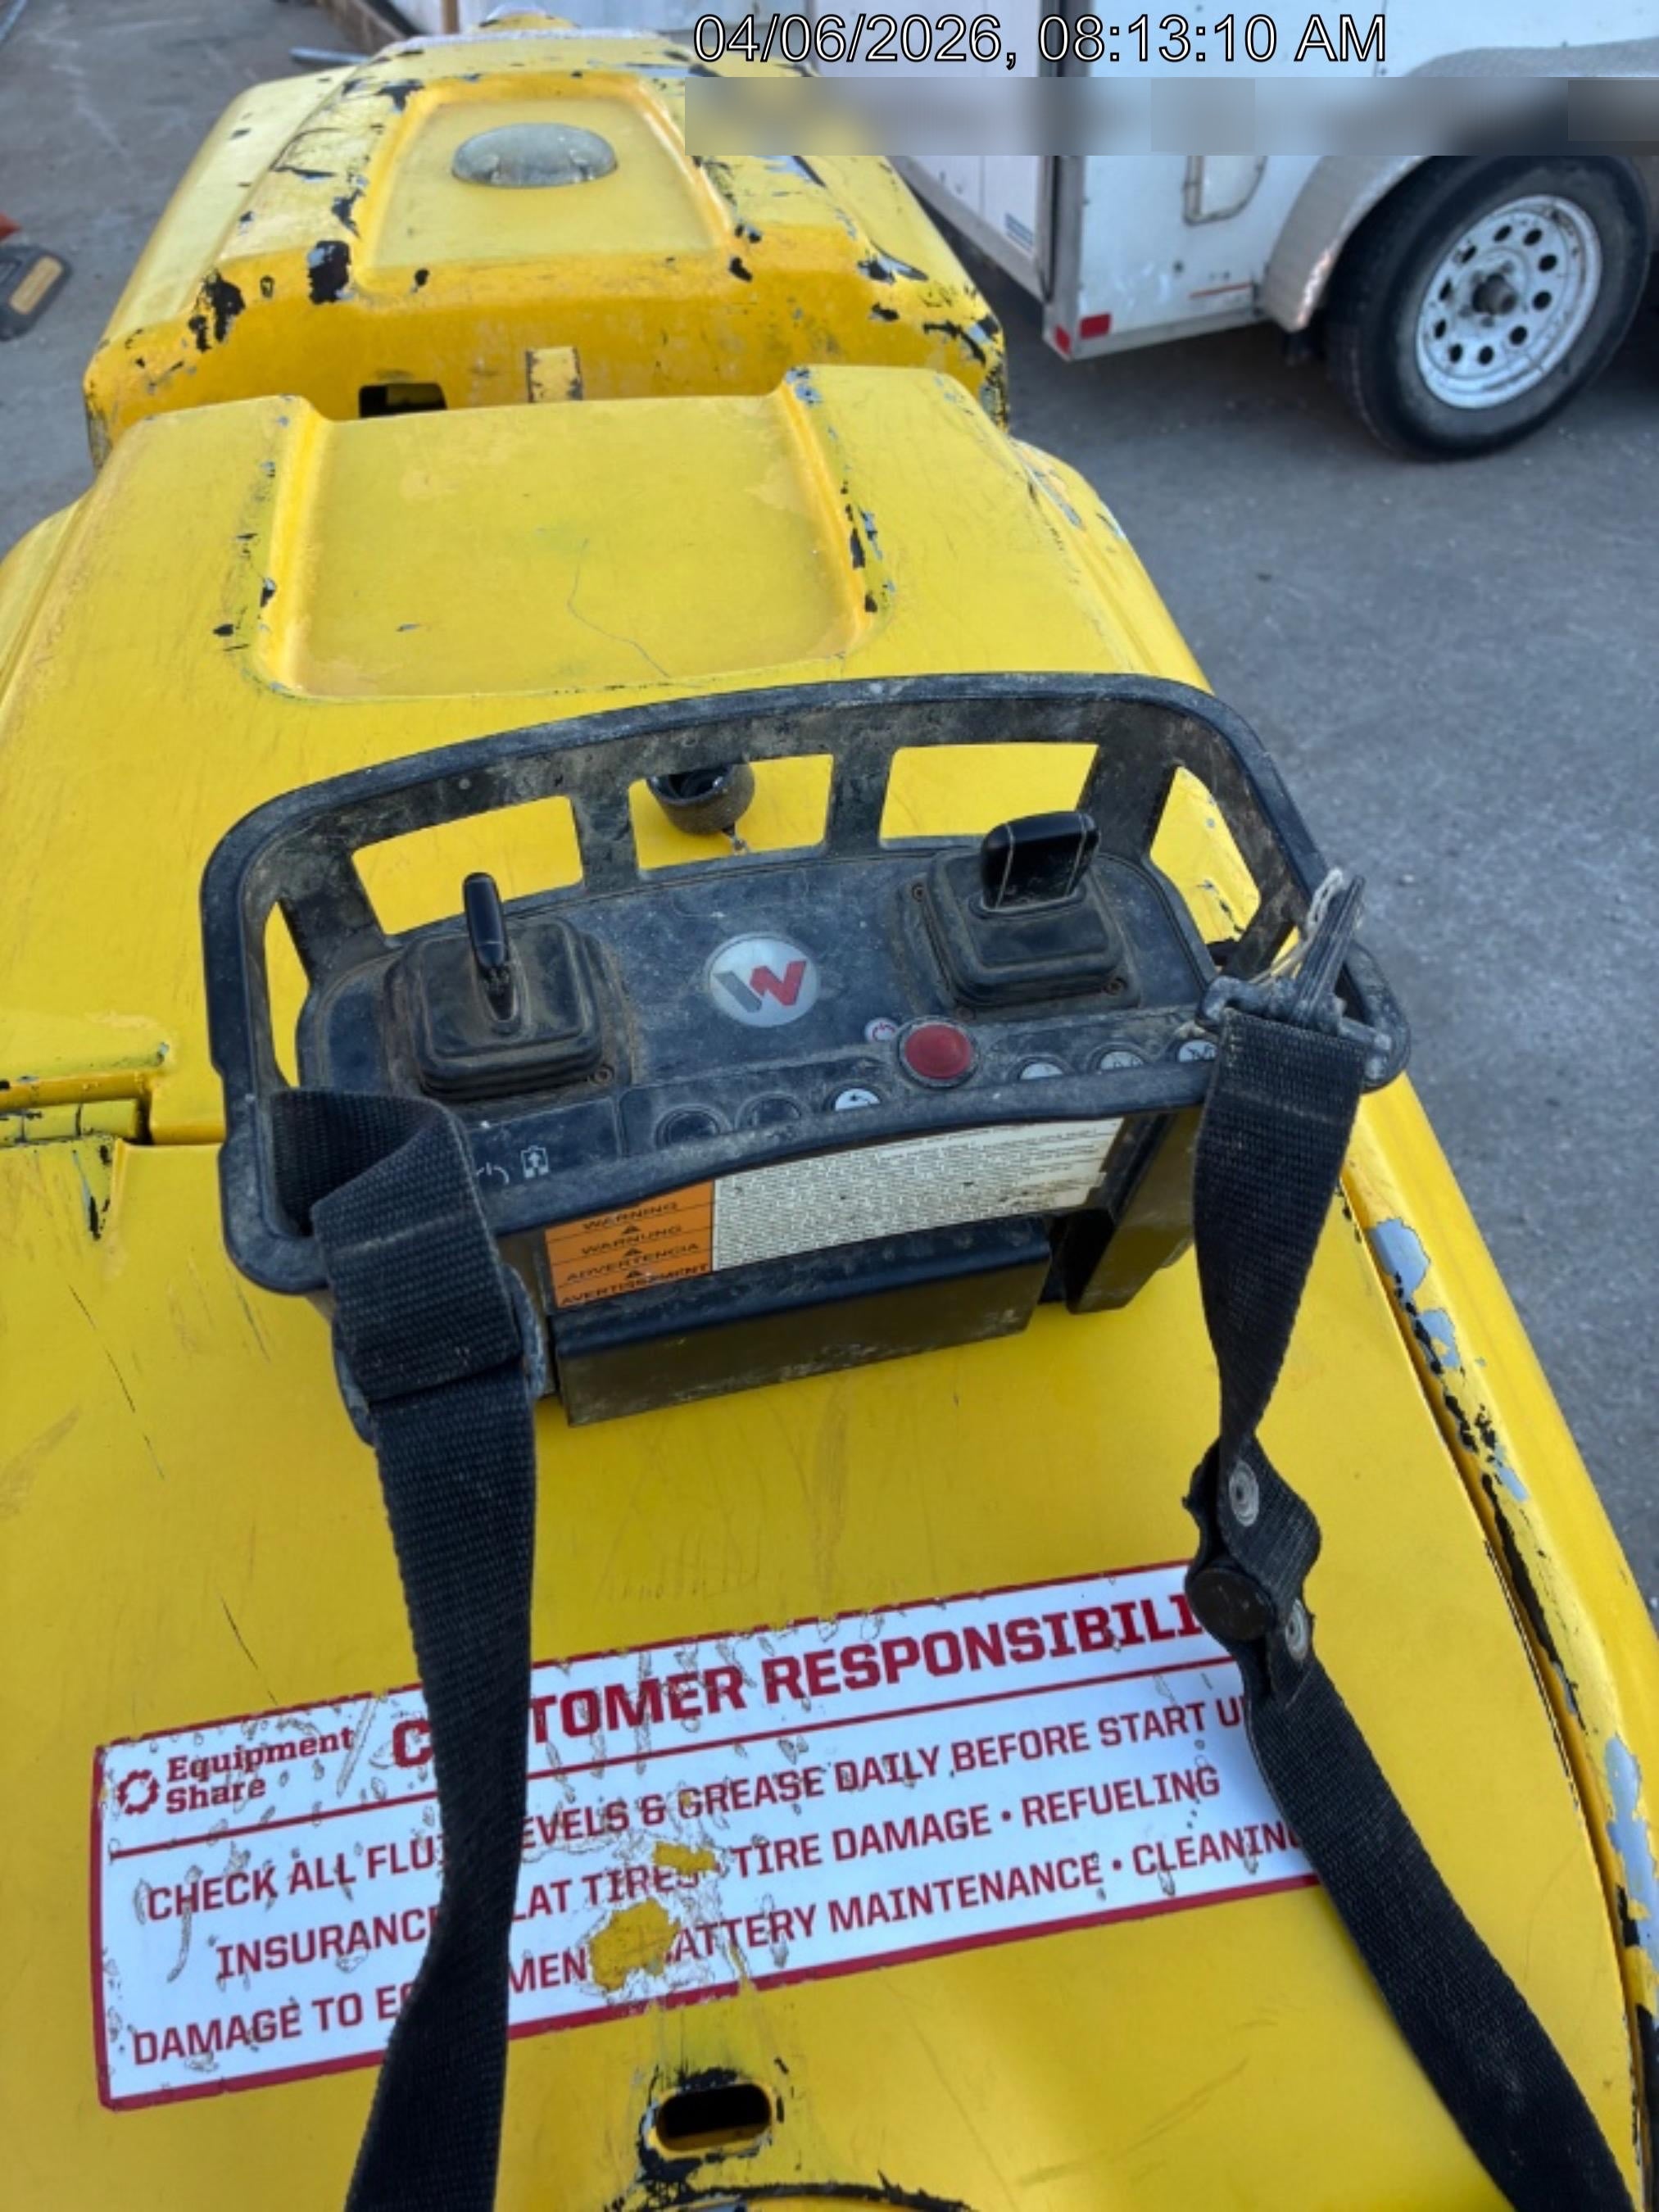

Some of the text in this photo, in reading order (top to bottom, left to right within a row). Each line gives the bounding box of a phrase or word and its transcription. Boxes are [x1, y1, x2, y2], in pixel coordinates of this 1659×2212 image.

[147, 1869, 279, 1921] CHECK
[289, 1856, 356, 1895] ALL
[522, 1801, 629, 1849] EVELS
[641, 1794, 666, 1826] &
[679, 1767, 824, 1819] GREASE
[835, 1746, 940, 1793] DAILY
[951, 1721, 1090, 1773] BEFORE
[1098, 1702, 1207, 1747] START
[166, 1727, 354, 1783] Equipment
[166, 1777, 266, 1814] Share
[729, 1834, 822, 1879] TIRE
[832, 1804, 992, 1862] DAMAGE
[1022, 1765, 1220, 1828] REFUELING
[133, 2003, 301, 2065] DAMAGE
[312, 1993, 364, 2032] TO
[665, 1905, 818, 1964] ATTERY
[829, 1854, 1104, 1929] MAINTENANCE
